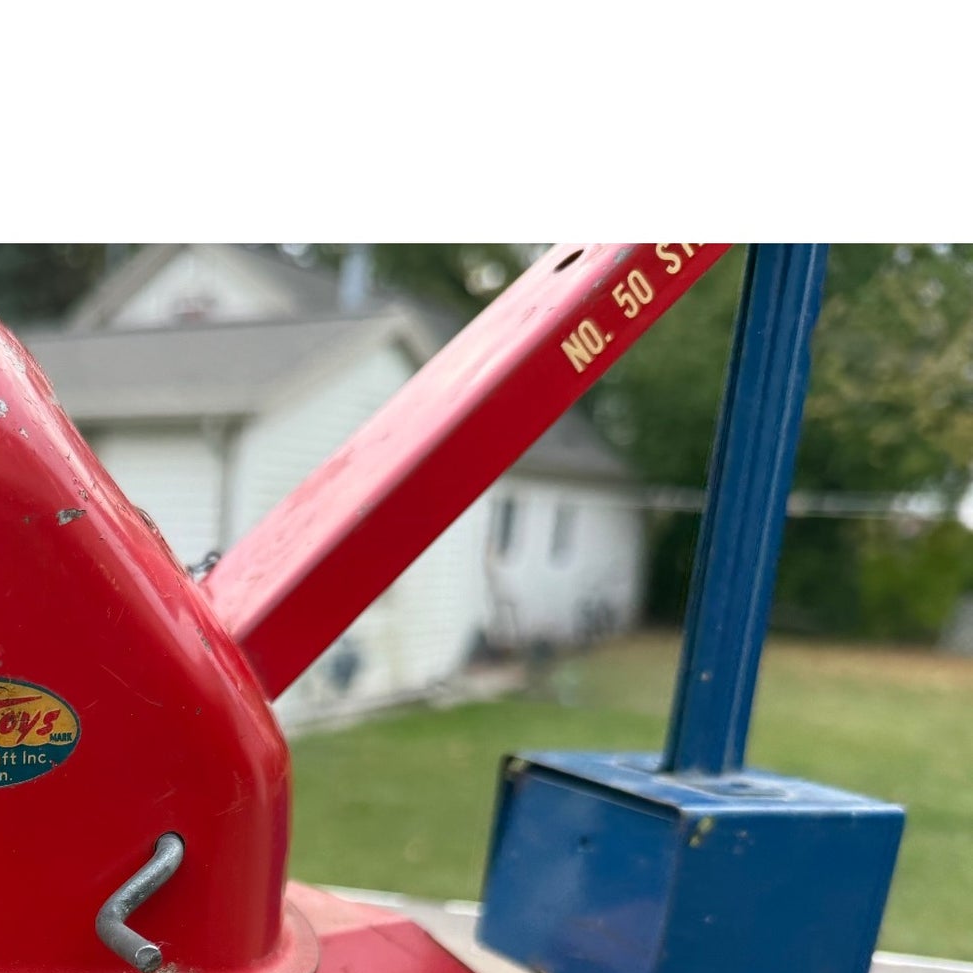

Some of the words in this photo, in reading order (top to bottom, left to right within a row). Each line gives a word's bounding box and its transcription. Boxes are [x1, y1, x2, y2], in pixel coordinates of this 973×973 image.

[560, 320, 614, 373] NO.
[612, 269, 653, 319] 50
[49, 732, 73, 742] MARK
[22, 751, 53, 765] Inc.
